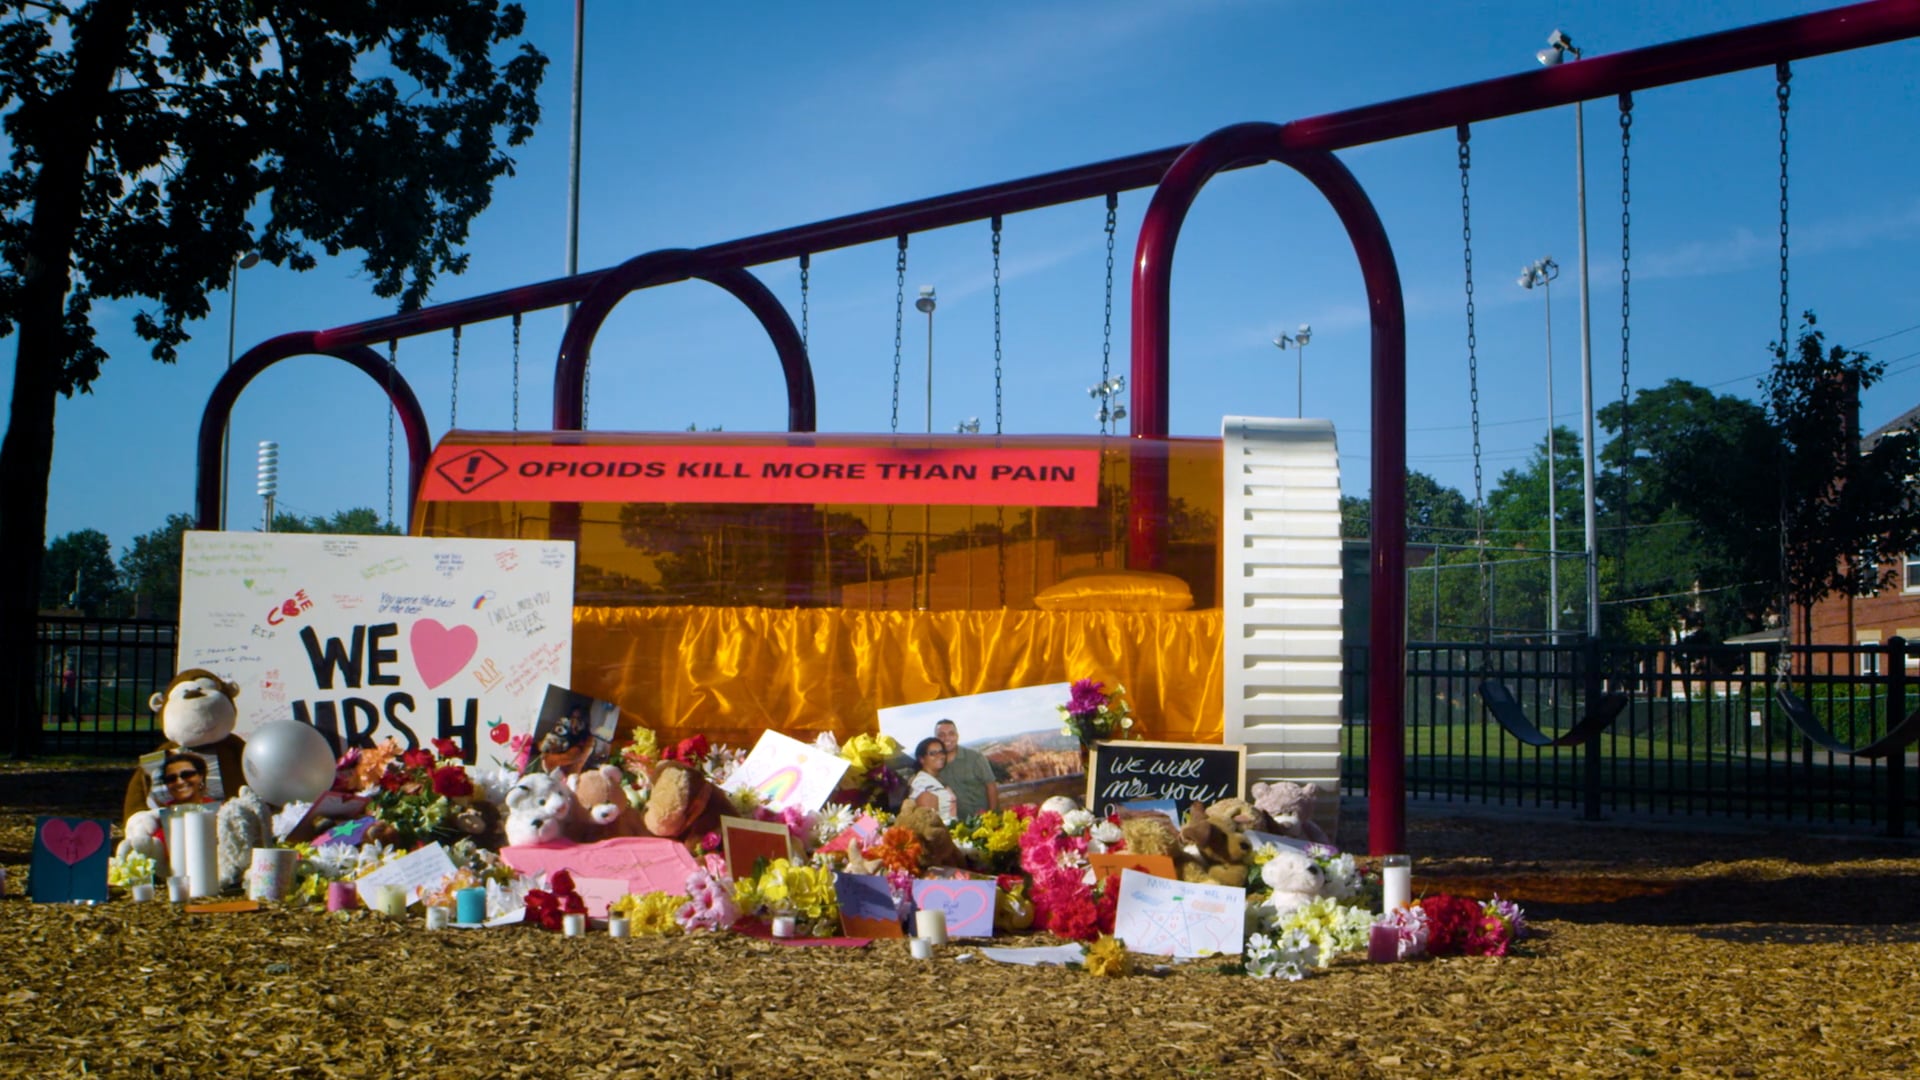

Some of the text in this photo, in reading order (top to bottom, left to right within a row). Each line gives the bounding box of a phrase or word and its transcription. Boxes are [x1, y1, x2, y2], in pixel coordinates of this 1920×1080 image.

[518, 461, 1075, 482] OPIOIDS KILL MORE THAN PAIN
[251, 624, 276, 640] RIP
[299, 622, 400, 690] WE
[473, 656, 503, 690] RIP
[437, 697, 479, 766] H
